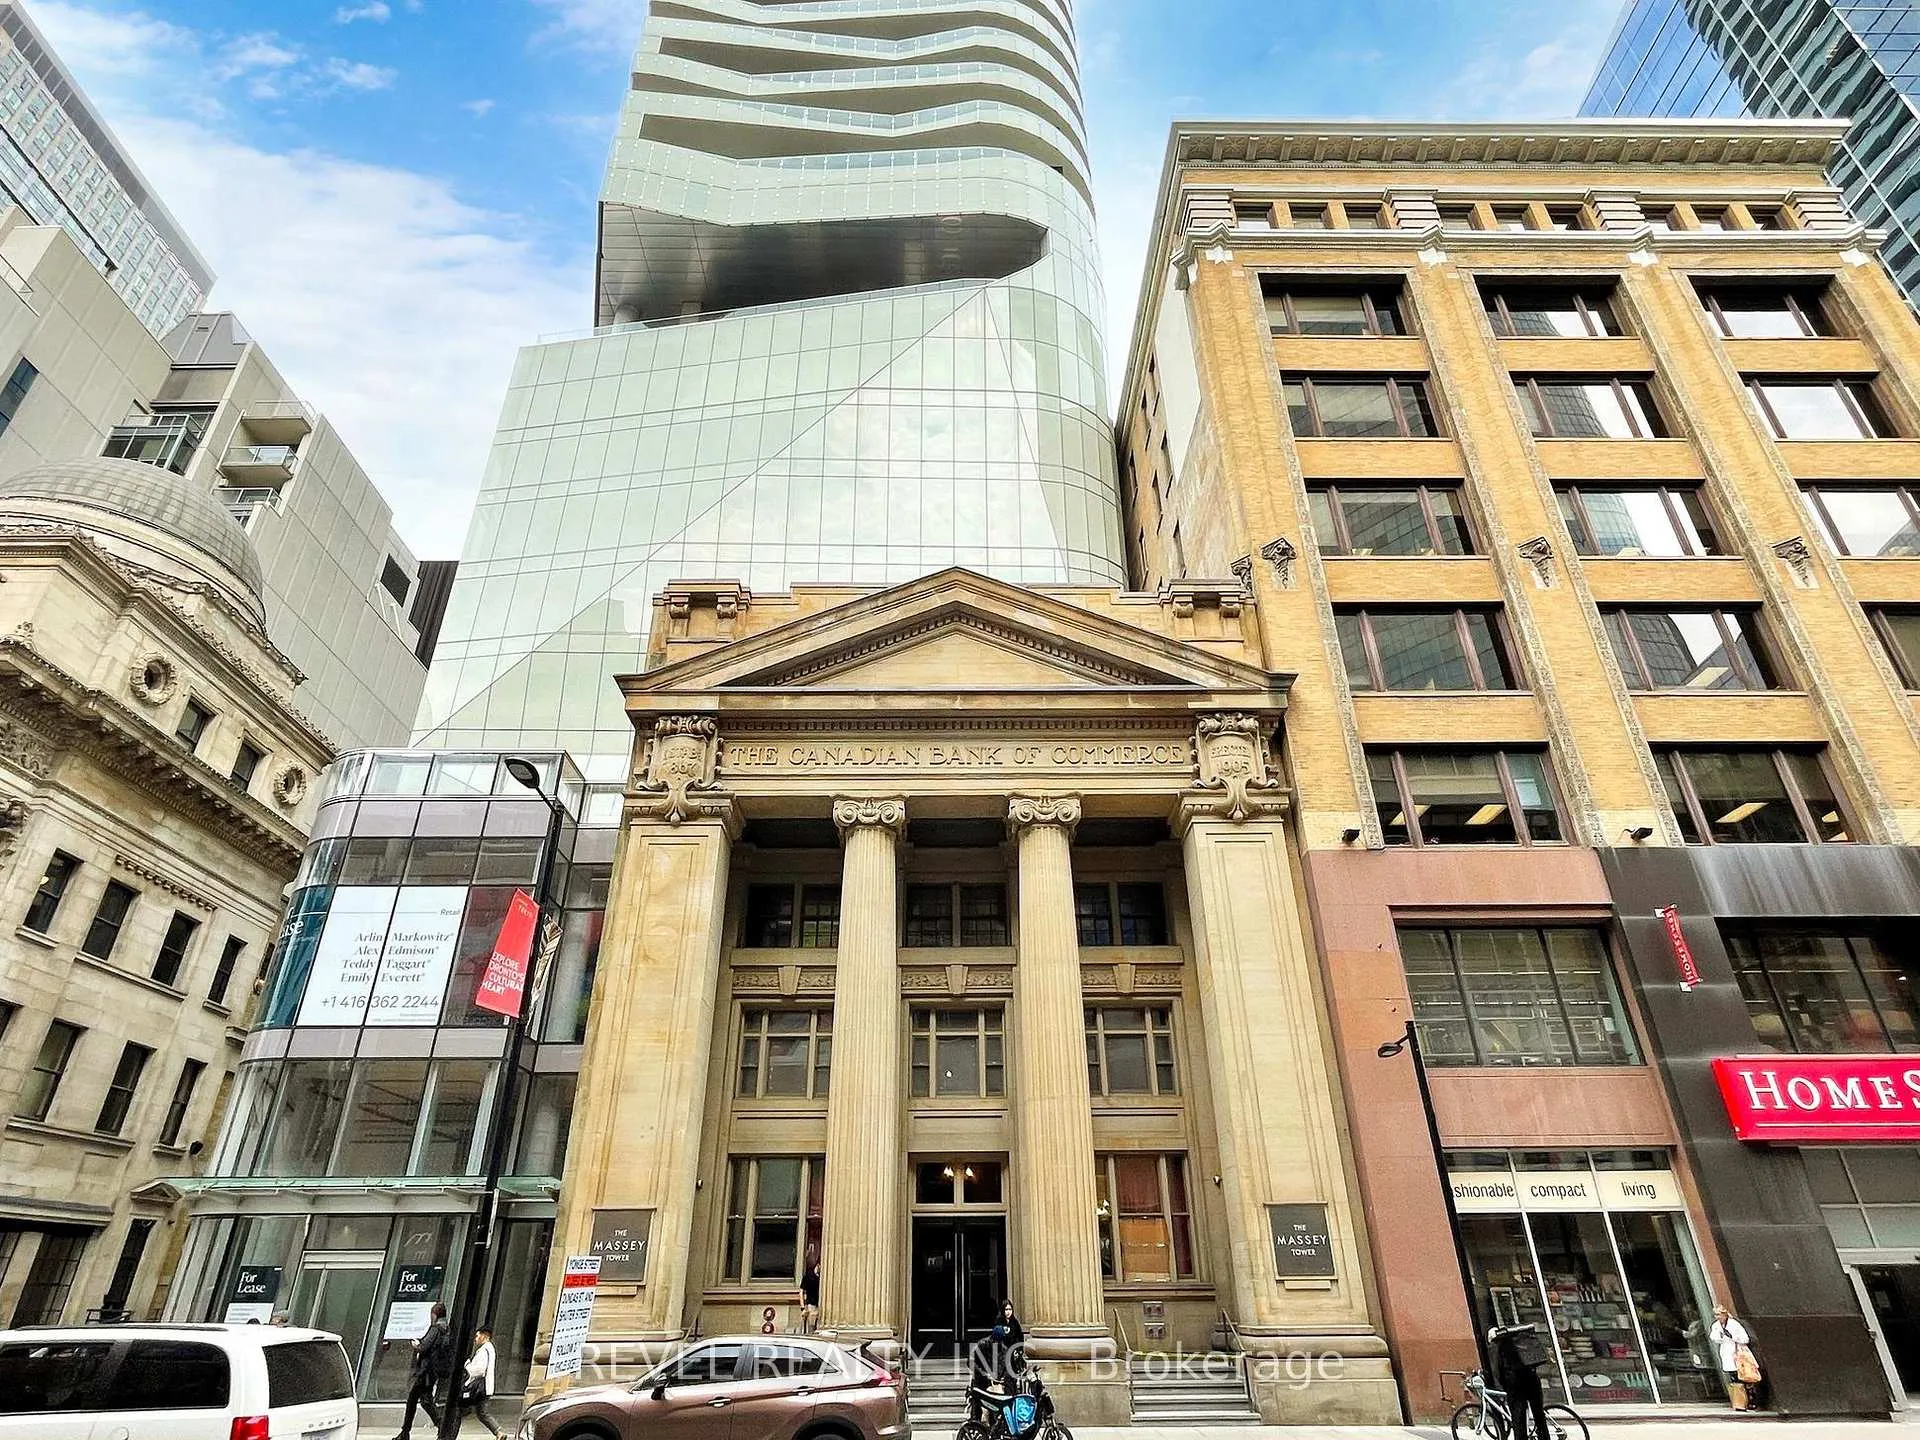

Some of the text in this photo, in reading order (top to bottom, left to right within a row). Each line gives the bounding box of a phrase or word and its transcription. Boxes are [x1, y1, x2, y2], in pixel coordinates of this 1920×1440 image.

[731, 746, 1185, 766] THE CANADIAN BANK OF COMMERCE
[440, 908, 460, 916] Retail
[355, 932, 383, 942] Arlin
[355, 946, 380, 955] Alex
[341, 959, 376, 971] Teddy
[340, 973, 373, 984] Emily
[481, 981, 506, 996] HEART
[321, 995, 440, 1008] +1 416 362 2244
[1452, 1181, 1657, 1200] shionable compact living
[614, 1229, 628, 1237] THE
[1277, 1234, 1327, 1245] MASSEY
[593, 1240, 646, 1251] MASSEY
[1290, 1248, 1317, 1256] TOWER
[606, 1254, 630, 1262] TOWER
[240, 1271, 259, 1283] For
[401, 1270, 419, 1282] For
[236, 1282, 267, 1294] Lease
[398, 1281, 428, 1293] Lease
